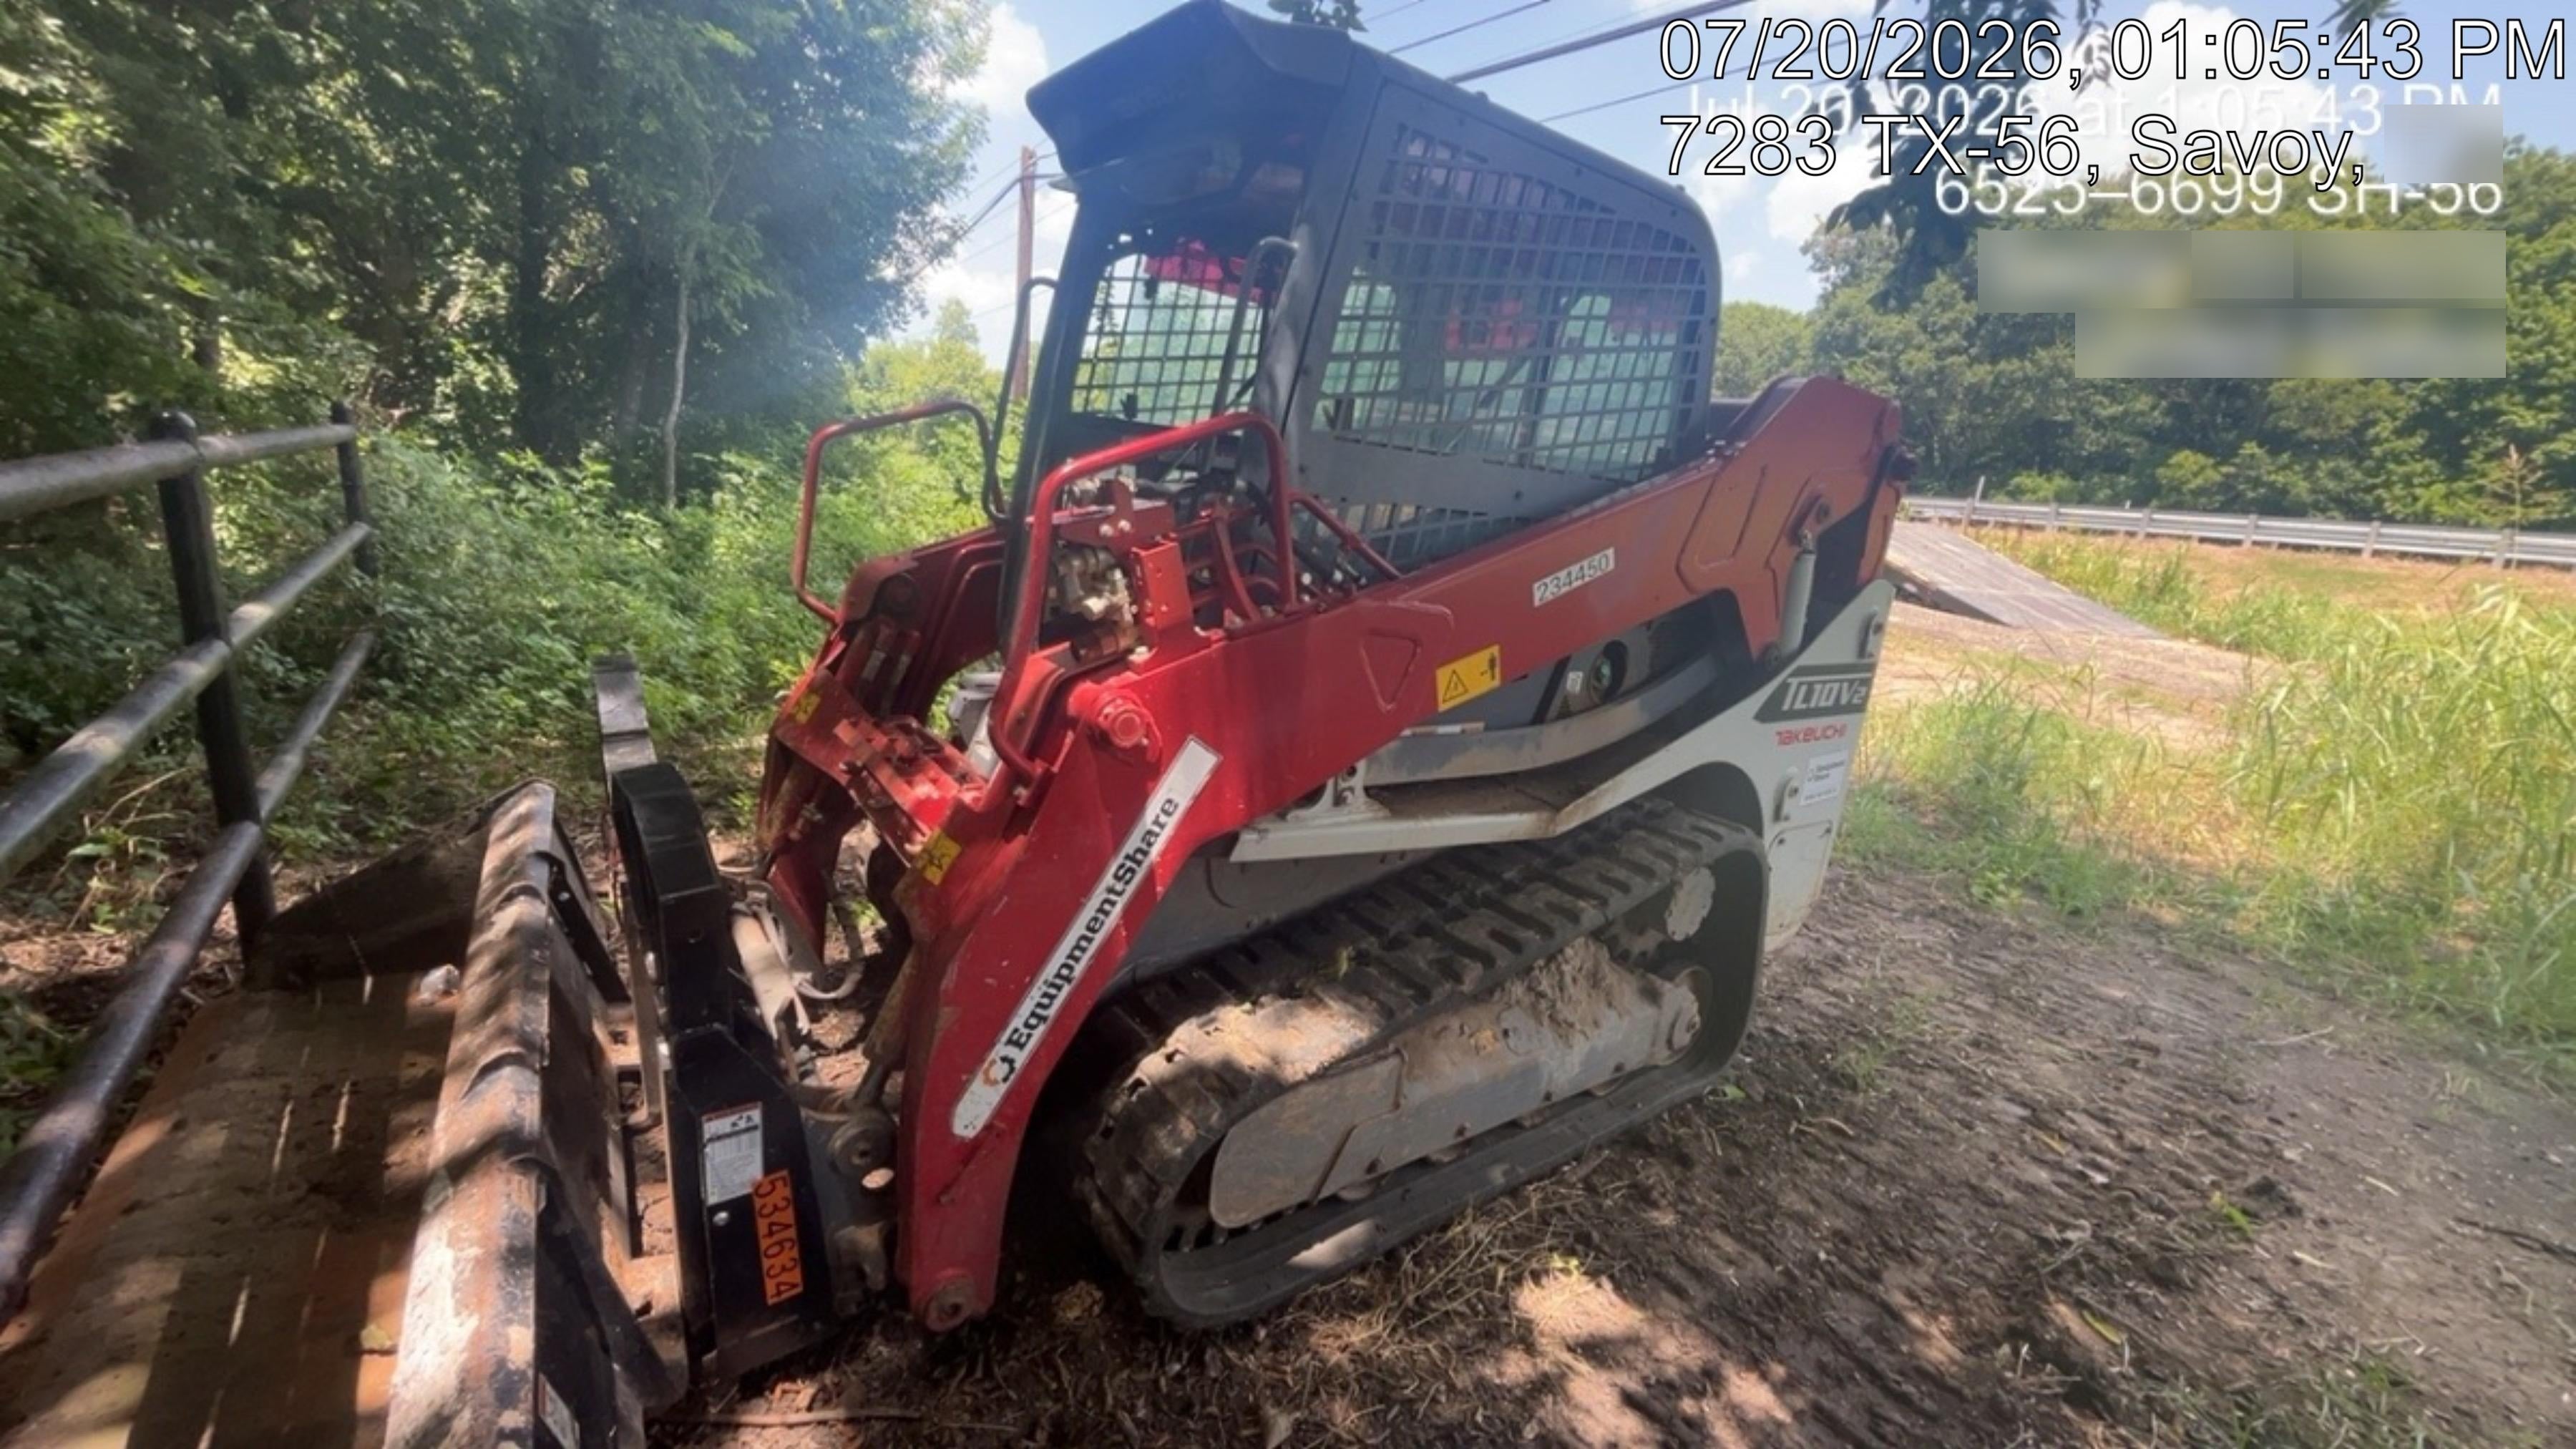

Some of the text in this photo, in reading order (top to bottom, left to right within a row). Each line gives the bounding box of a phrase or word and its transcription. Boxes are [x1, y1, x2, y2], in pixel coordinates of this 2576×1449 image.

[1536, 553, 1611, 602] 234450
[1005, 796, 1179, 1052] EquipmentShare
[755, 1176, 799, 1300] 534634
